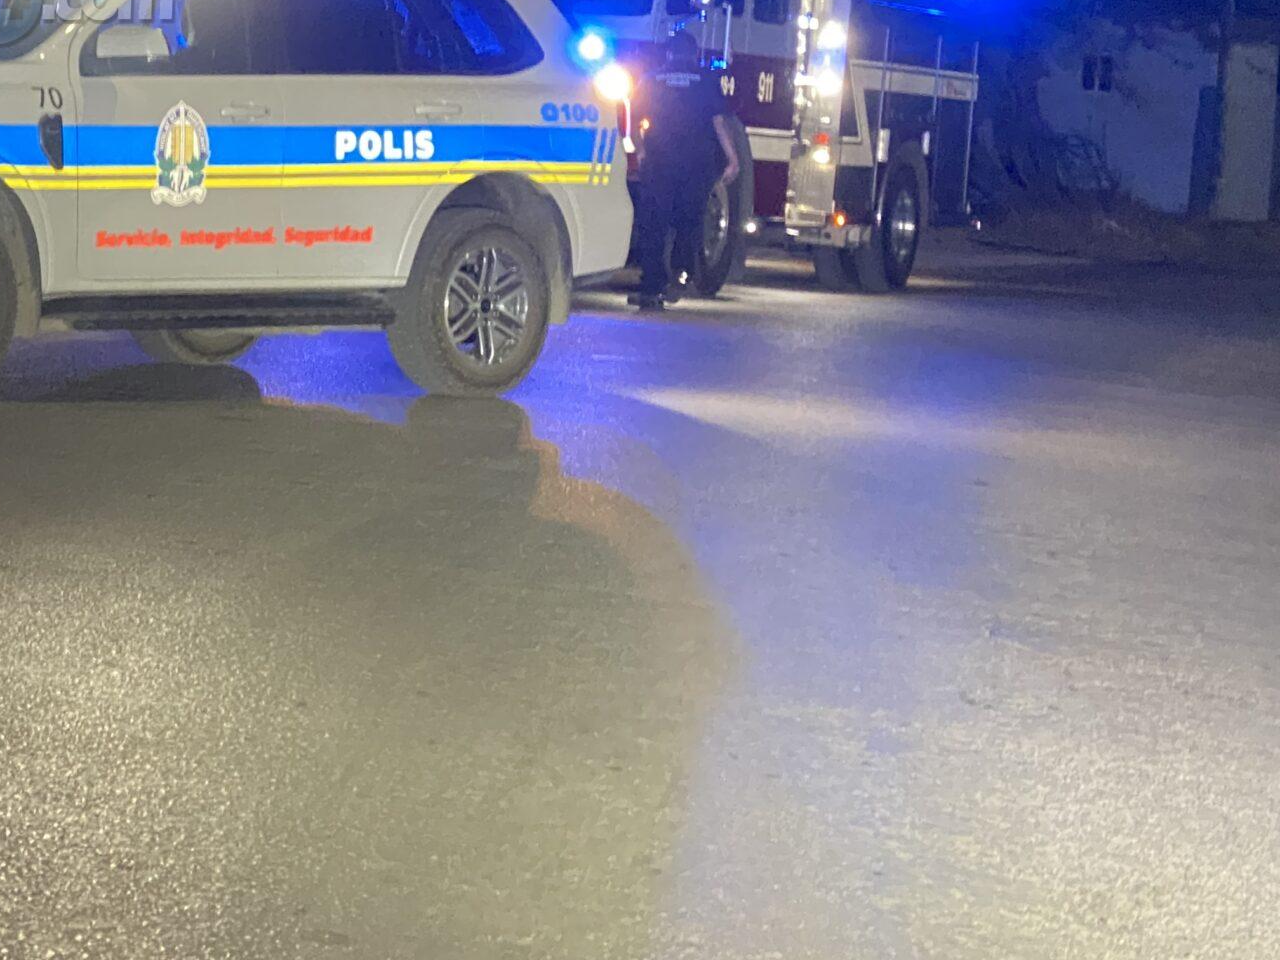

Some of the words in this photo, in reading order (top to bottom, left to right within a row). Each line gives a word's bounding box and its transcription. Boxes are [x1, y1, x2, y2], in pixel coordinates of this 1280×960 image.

[31, 86, 63, 109] 70
[758, 71, 774, 103] 911
[335, 129, 435, 161] POLIS
[284, 225, 374, 248] Seguridad
